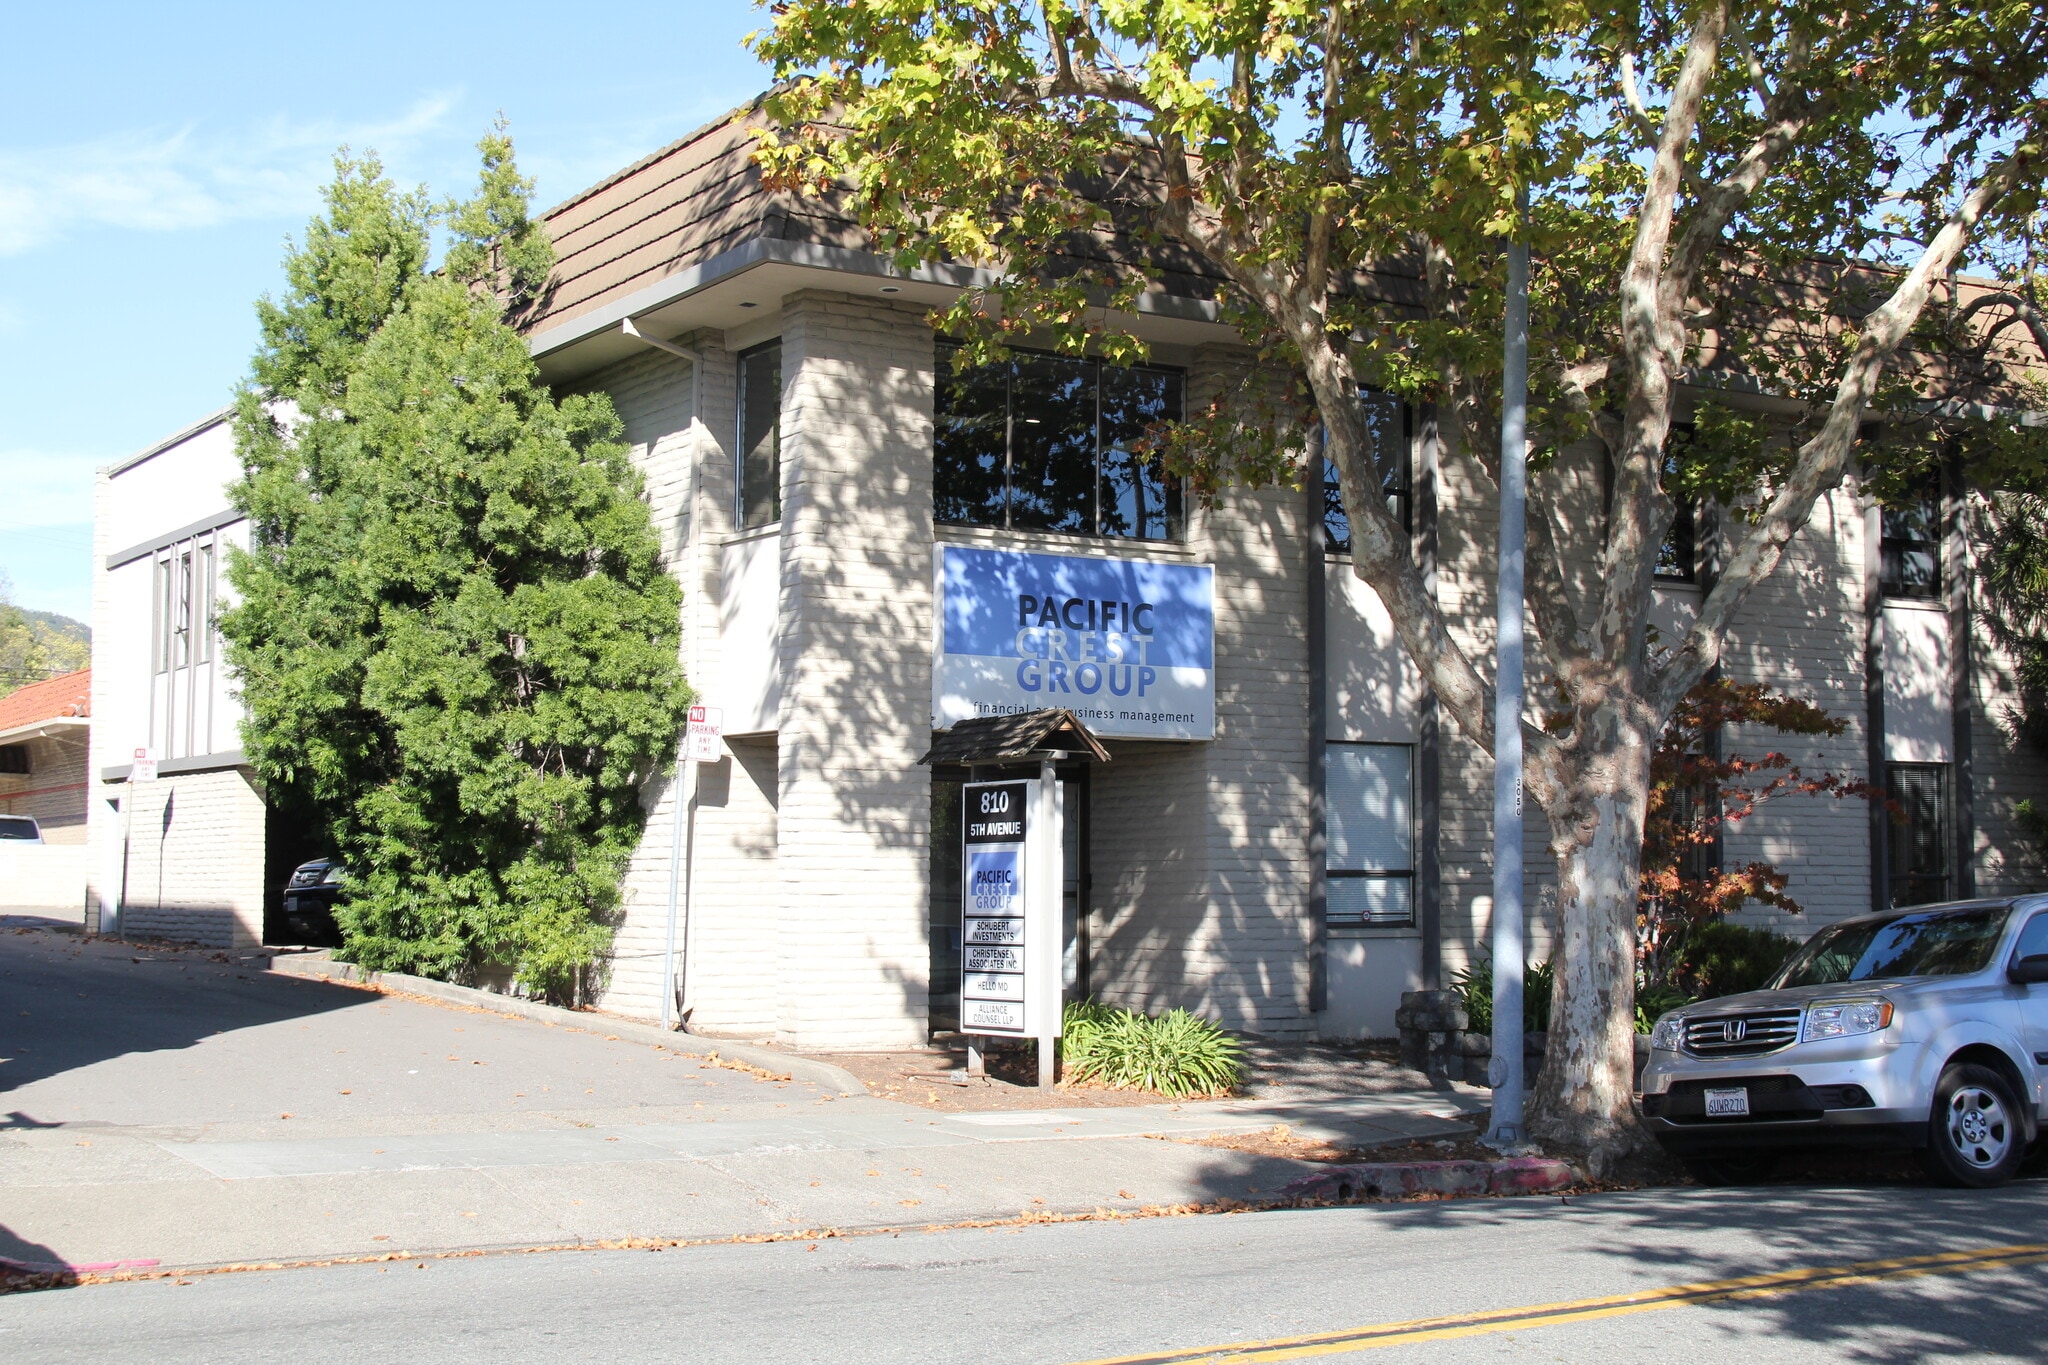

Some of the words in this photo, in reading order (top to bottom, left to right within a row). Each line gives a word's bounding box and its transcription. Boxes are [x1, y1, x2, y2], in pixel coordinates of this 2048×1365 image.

[1019, 594, 1154, 635] PACIFIC
[1015, 627, 1154, 666] CREST
[1016, 659, 1156, 697] GROUP
[692, 708, 704, 720] NO
[973, 702, 1029, 714] financial
[1063, 706, 1115, 720] usiness
[1120, 711, 1195, 723] management
[692, 724, 719, 735] PARKING
[698, 746, 711, 754] TIME
[980, 791, 1009, 814] 810
[970, 823, 986, 836] 5TH
[987, 822, 1021, 836] AVENUE
[977, 870, 1012, 883] PACIFIC
[976, 883, 1012, 896] CREST
[976, 895, 1012, 908] GROUP
[977, 921, 1010, 931] SCHUBERT
[972, 931, 1015, 941] INVESTMENTS
[972, 949, 1015, 959] CHRISTENSEN
[969, 959, 1004, 968] ASSOCIATES
[977, 981, 996, 990] HELLO
[998, 982, 1008, 991] MD
[979, 1004, 1008, 1014] ALLIANCE
[973, 1014, 1001, 1024] COUNSEL
[1003, 1015, 1014, 1025] LLP
